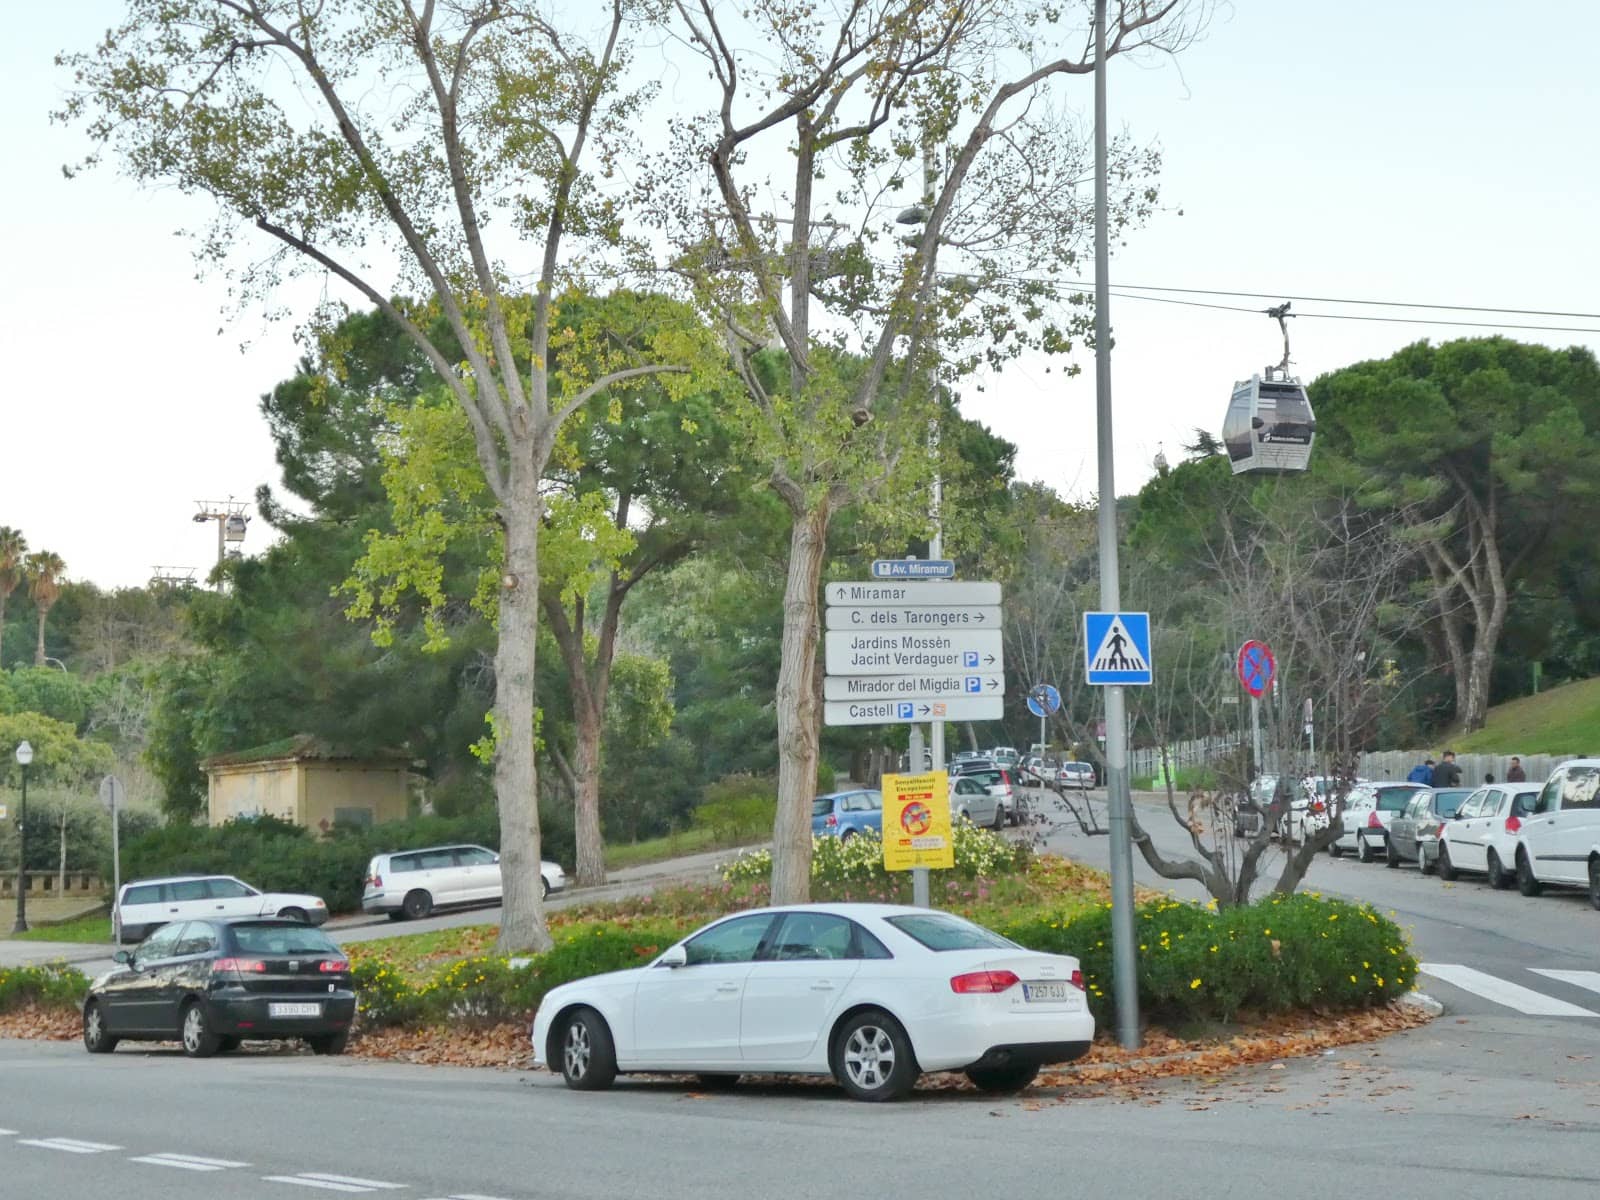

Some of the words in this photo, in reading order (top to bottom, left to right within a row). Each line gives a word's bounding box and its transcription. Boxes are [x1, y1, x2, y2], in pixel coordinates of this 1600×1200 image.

[892, 564, 907, 574] Av.
[909, 563, 949, 575] Miramar
[851, 587, 906, 600] Miramar
[851, 610, 864, 624] C.
[870, 610, 898, 624] dels
[903, 610, 969, 626] Tarongers
[851, 636, 898, 650] Jardins
[902, 635, 951, 649] Mossèn
[851, 652, 890, 666] Jacint
[894, 651, 959, 668] Verdaguer
[965, 652, 977, 667] P
[848, 679, 895, 694] Mirador
[897, 678, 916, 692] del
[919, 677, 960, 694] Migdia
[967, 677, 979, 693] P
[849, 703, 894, 718] Castell
[900, 703, 912, 719] P
